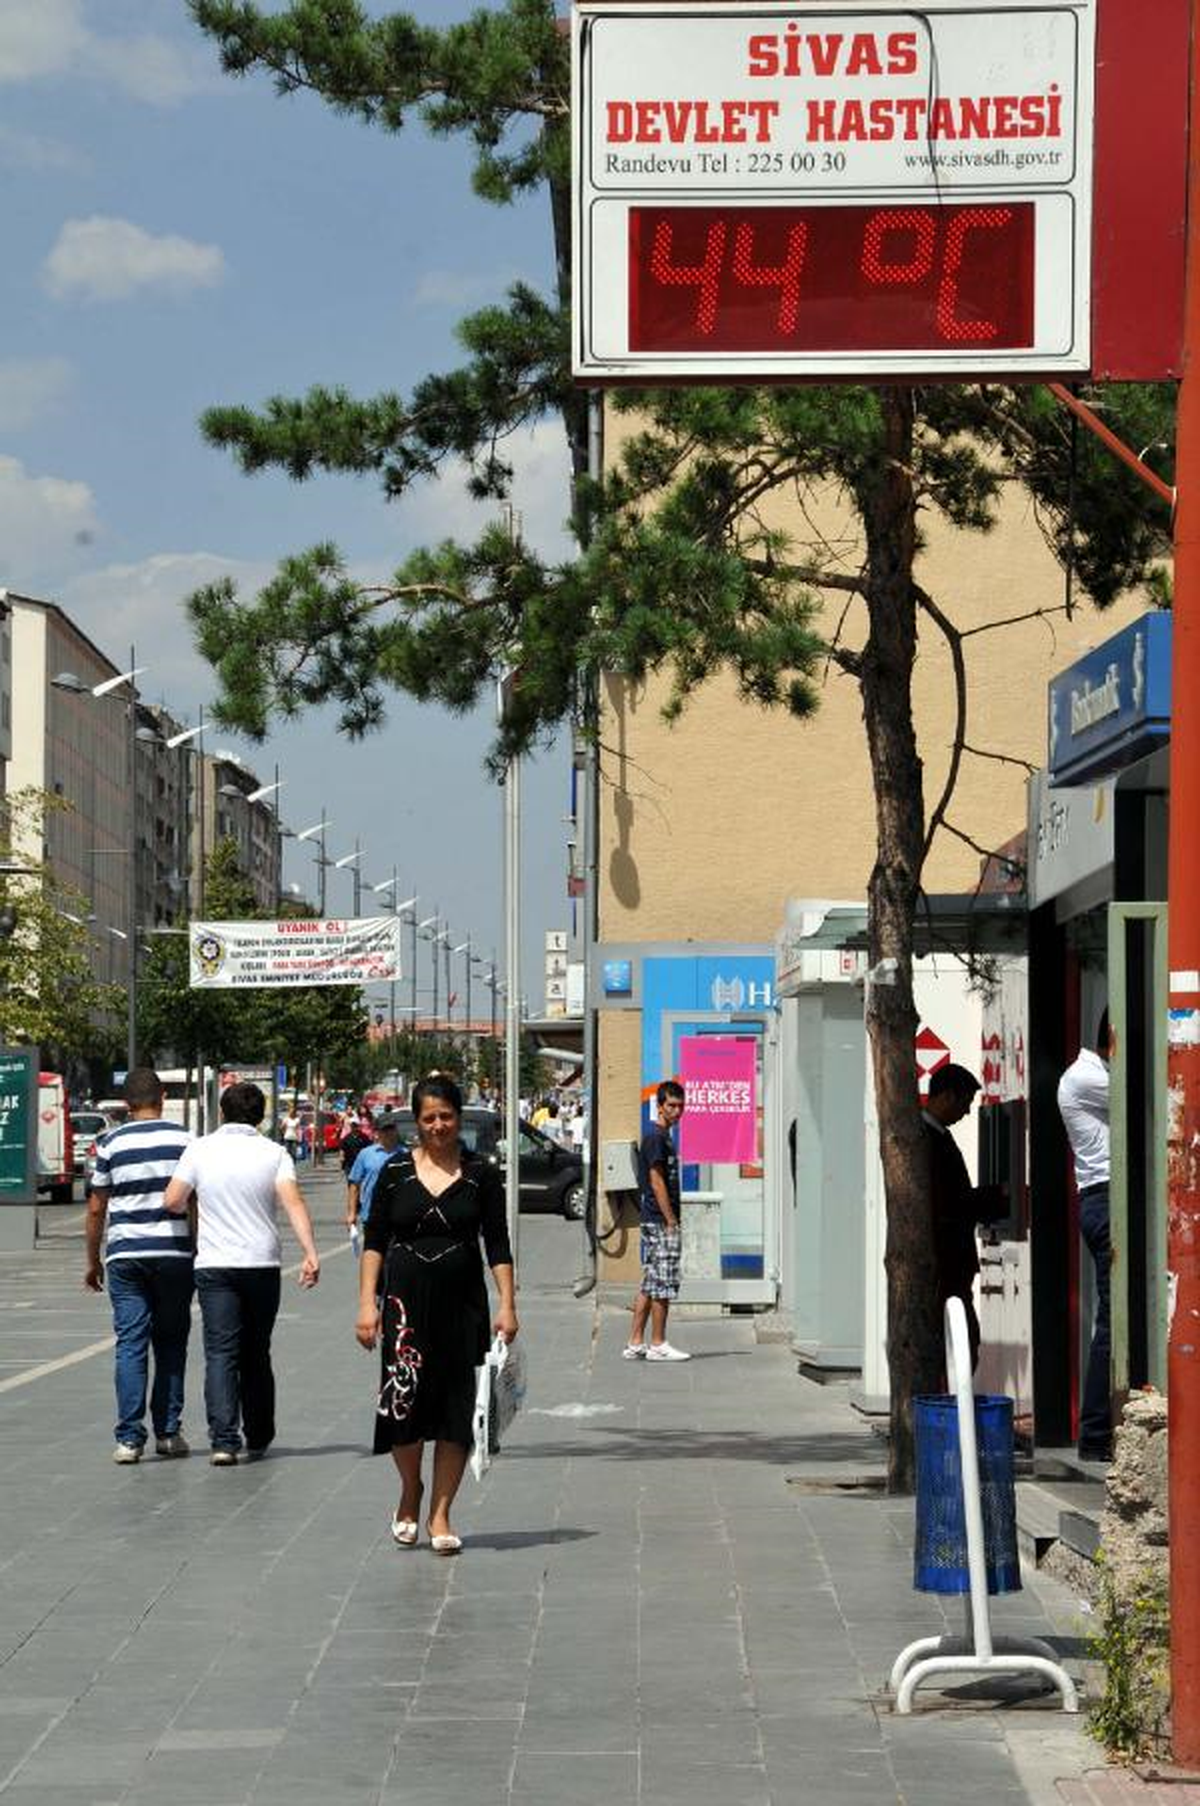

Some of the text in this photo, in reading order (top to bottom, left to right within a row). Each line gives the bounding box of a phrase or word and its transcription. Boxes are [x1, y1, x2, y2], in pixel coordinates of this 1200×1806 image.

[748, 22, 917, 77] SİVAS
[606, 83, 1062, 143] DEVLET HASTANESİ
[605, 154, 691, 174] Randevu
[697, 154, 728, 173] Tel
[748, 153, 784, 173] 225
[790, 154, 816, 172] 00
[822, 152, 846, 172] 30
[904, 150, 1062, 169] www.sivasdh.gov.tr
[650, 220, 808, 336] 44
[685, 1090, 751, 1105] HERKES
